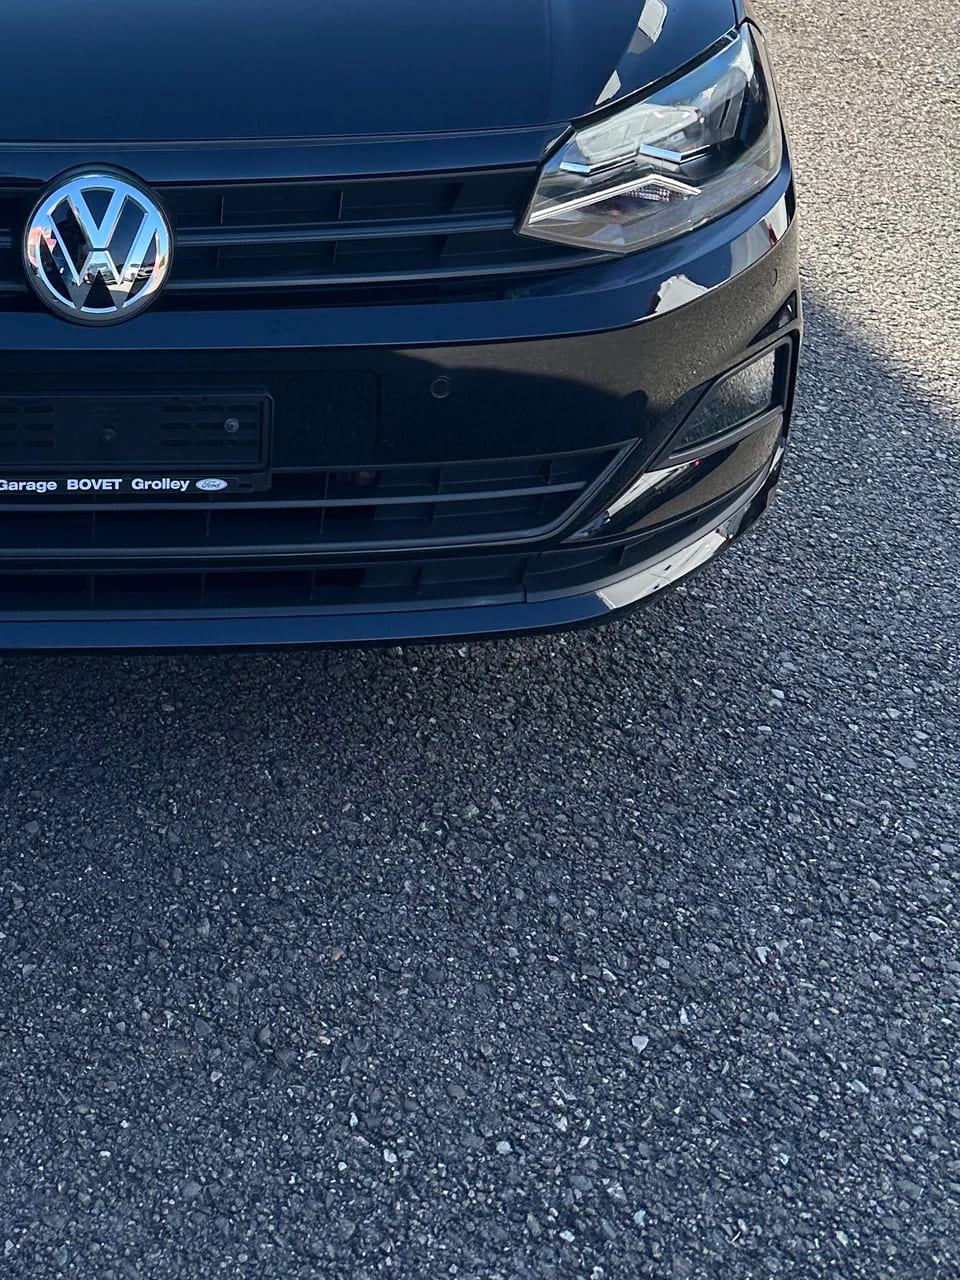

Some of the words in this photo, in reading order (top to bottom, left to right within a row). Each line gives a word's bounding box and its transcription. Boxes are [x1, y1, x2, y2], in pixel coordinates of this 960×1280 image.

[26, 175, 169, 319] VW
[66, 478, 122, 490] BOVET
[131, 478, 190, 492] Grolley
